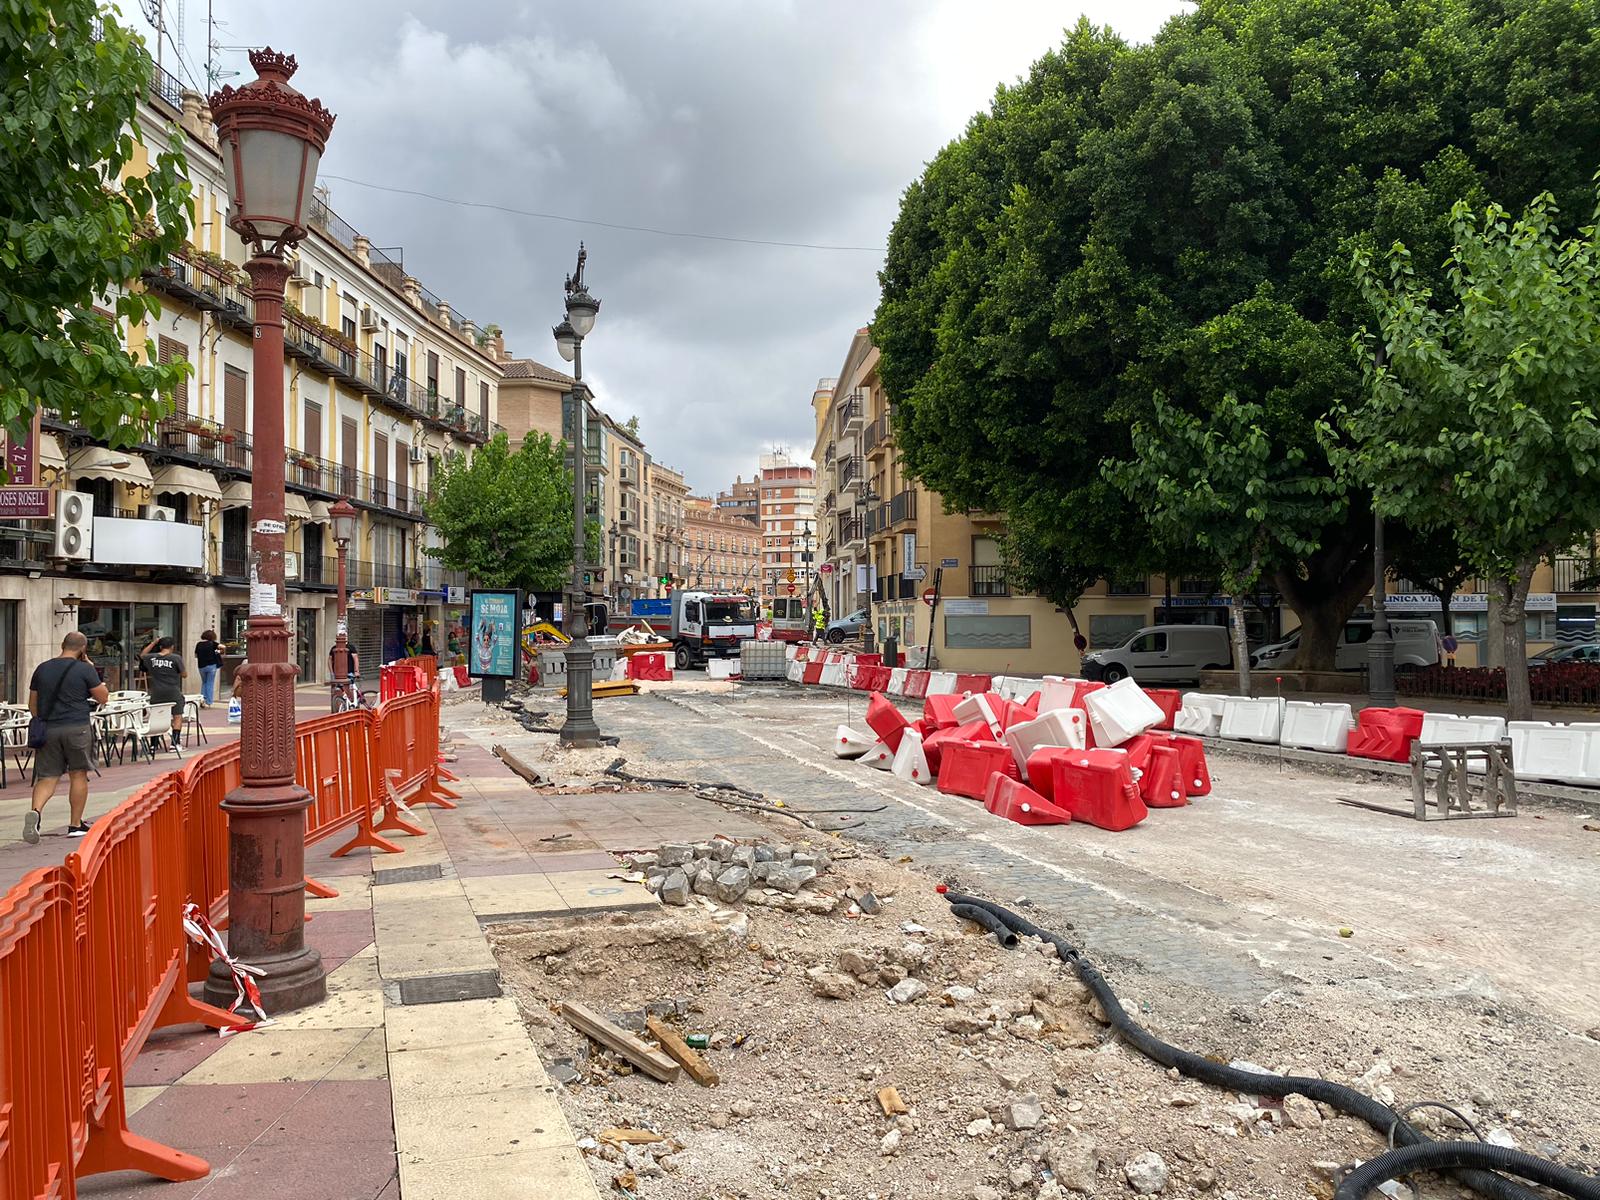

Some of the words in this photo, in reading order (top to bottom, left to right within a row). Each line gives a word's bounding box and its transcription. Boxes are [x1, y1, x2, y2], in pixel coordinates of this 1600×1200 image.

[0, 491, 17, 506] OSES
[18, 491, 45, 506] ROSELL
[1384, 594, 1418, 604] LINICA
[1463, 594, 1477, 603] DE
[648, 655, 655, 665] P
